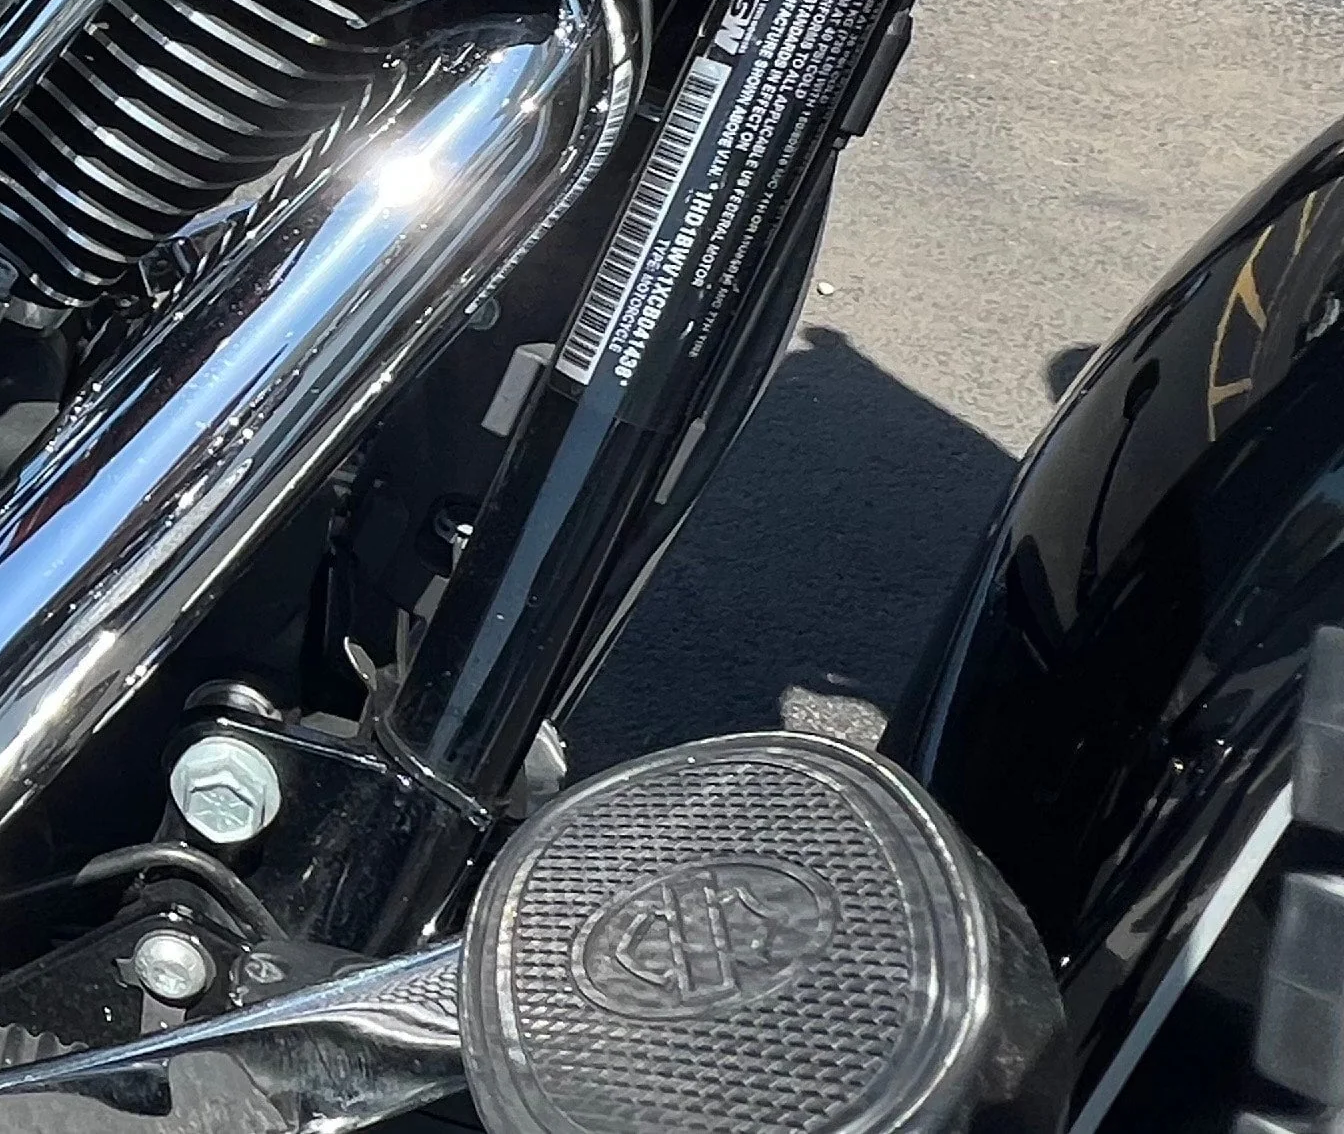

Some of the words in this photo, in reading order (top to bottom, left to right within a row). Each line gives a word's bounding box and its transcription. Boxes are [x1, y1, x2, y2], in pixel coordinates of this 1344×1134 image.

[829, 6, 844, 25] AT
[765, 68, 783, 83] IN
[778, 68, 799, 92] ALL
[791, 52, 809, 69] TO
[736, 58, 768, 105] SHOWN
[794, 64, 818, 99] COLD
[717, 104, 747, 148] ABOVE
[744, 83, 776, 131] EFFECT
[734, 130, 754, 151] ON
[745, 93, 787, 168] APPLICABLE
[736, 169, 754, 187] US
[710, 188, 745, 241] FEDERAL
[691, 243, 719, 287] MOTOR
[608, 273, 653, 352] MOTORCYCLE
